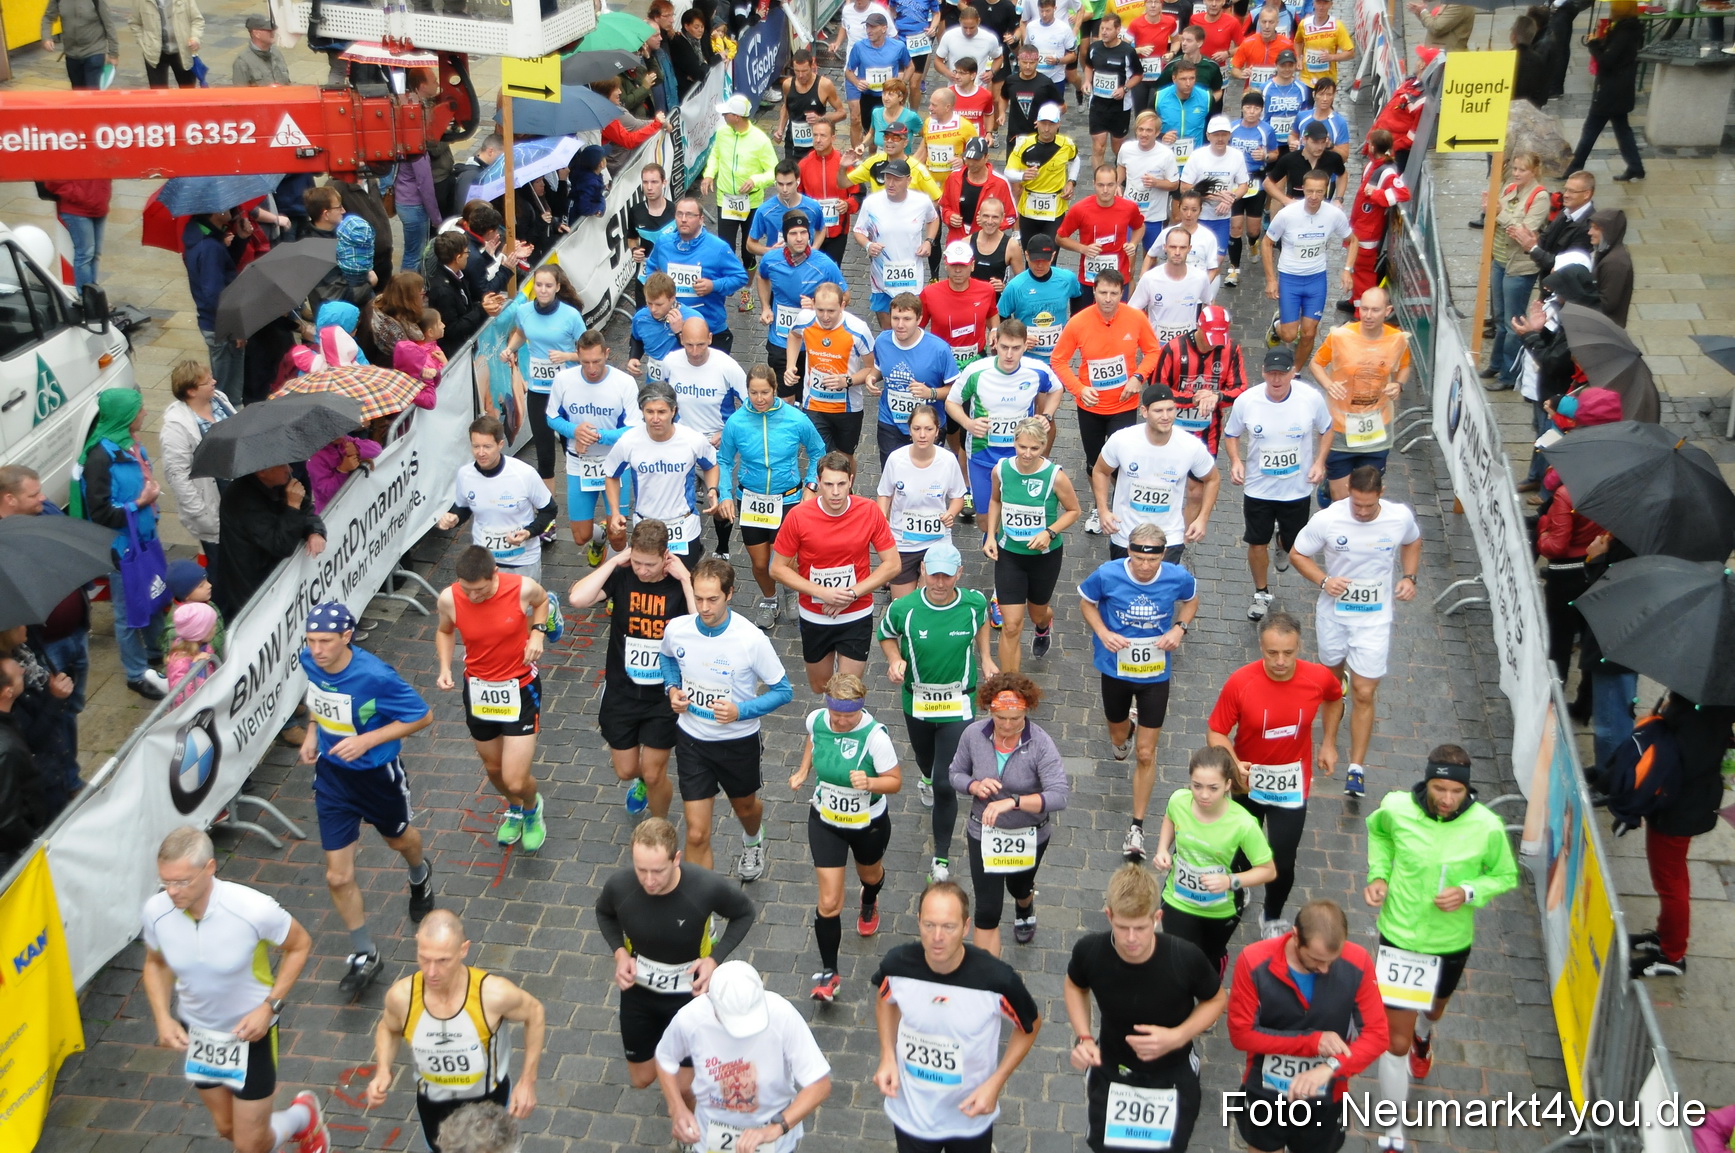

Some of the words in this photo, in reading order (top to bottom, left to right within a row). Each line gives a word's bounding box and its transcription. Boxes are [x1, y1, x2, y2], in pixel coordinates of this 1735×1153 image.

[872, 73, 887, 83] 111
[1095, 79, 1116, 90] 2528
[1445, 79, 1510, 98] Jugend-
[1461, 98, 1491, 114] lauf
[0, 127, 86, 151] eline:
[95, 123, 176, 149] 09181
[185, 121, 256, 146] 6352
[794, 128, 812, 139] 208
[931, 152, 948, 162] 513
[1032, 199, 1050, 210] 195
[1301, 247, 1320, 258] 262
[886, 268, 914, 280] 2346
[1088, 261, 1115, 273] 2325
[615, 259, 638, 292] stadtw
[671, 272, 698, 284] 2969
[779, 314, 796, 326] 30
[1036, 333, 1059, 347] 512
[809, 349, 842, 359] SportScheck
[650, 366, 662, 379] 29
[1092, 364, 1124, 380] 2639
[674, 382, 718, 398] Gothaer
[1100, 379, 1120, 388] Andreas
[819, 392, 834, 400] David
[569, 402, 614, 417] Gothaer
[1177, 408, 1208, 420] 217
[1358, 419, 1374, 433] 39
[638, 459, 687, 475] Gothaer
[1263, 453, 1297, 468] 2490
[1133, 489, 1170, 504] 2492
[750, 500, 775, 514] 480
[906, 518, 941, 533] 3169
[1006, 513, 1042, 527] 2569
[667, 526, 683, 541] 99
[342, 557, 369, 599] Mehr
[367, 488, 427, 566] Fahrfreude.
[494, 550, 514, 558] Daniel
[230, 623, 281, 720] BMW
[285, 450, 420, 645] EfficientDynamics
[813, 575, 851, 588] 2627
[1341, 588, 1378, 602] 2491
[629, 592, 666, 616] RUN
[1345, 604, 1373, 612] Christian
[628, 617, 669, 639] FAS
[630, 649, 660, 667] 207
[1131, 648, 1151, 663] 66
[1121, 664, 1161, 673] Hans-Jürgen
[481, 690, 510, 705] 409
[313, 698, 342, 721] 581
[481, 706, 511, 716] Christoph
[1255, 773, 1298, 791] 2284
[829, 794, 860, 813] 305
[1263, 793, 1288, 802] Jochen
[834, 814, 853, 824] Karin
[992, 837, 1026, 853] 329
[993, 858, 1024, 866] Christine
[1178, 869, 1208, 892] 255
[646, 972, 680, 990] 121
[1387, 962, 1425, 987] 572
[192, 1040, 242, 1066] 2934
[905, 1042, 956, 1071] 2335
[428, 1054, 471, 1072] 369
[705, 1056, 722, 1069] 20.
[434, 1076, 471, 1084] Manfred
[917, 1069, 943, 1083] Martin
[1114, 1100, 1170, 1126] 2967
[1125, 1127, 1152, 1139] Moritz
